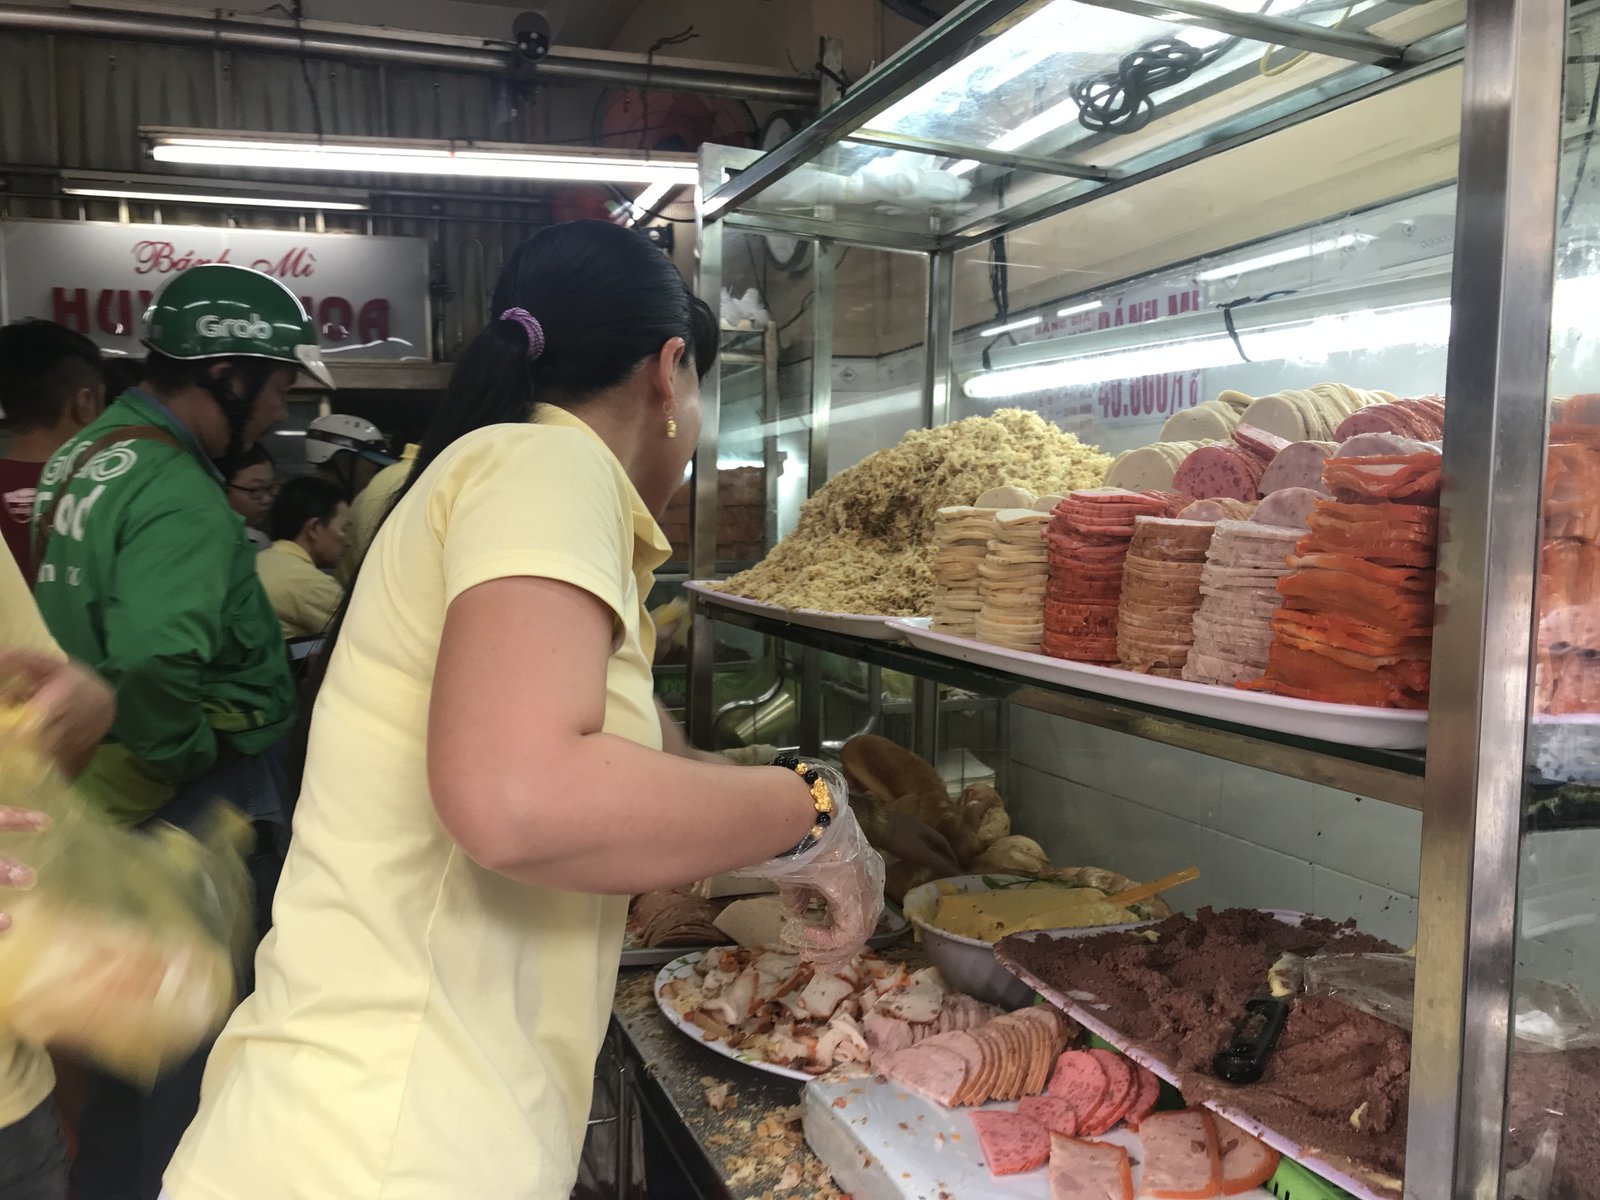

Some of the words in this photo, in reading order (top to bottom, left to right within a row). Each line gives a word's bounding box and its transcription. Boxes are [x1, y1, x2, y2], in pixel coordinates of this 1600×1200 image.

[251, 247, 316, 278] Mì
[196, 313, 273, 340] Grab
[32, 484, 107, 541] Fod
